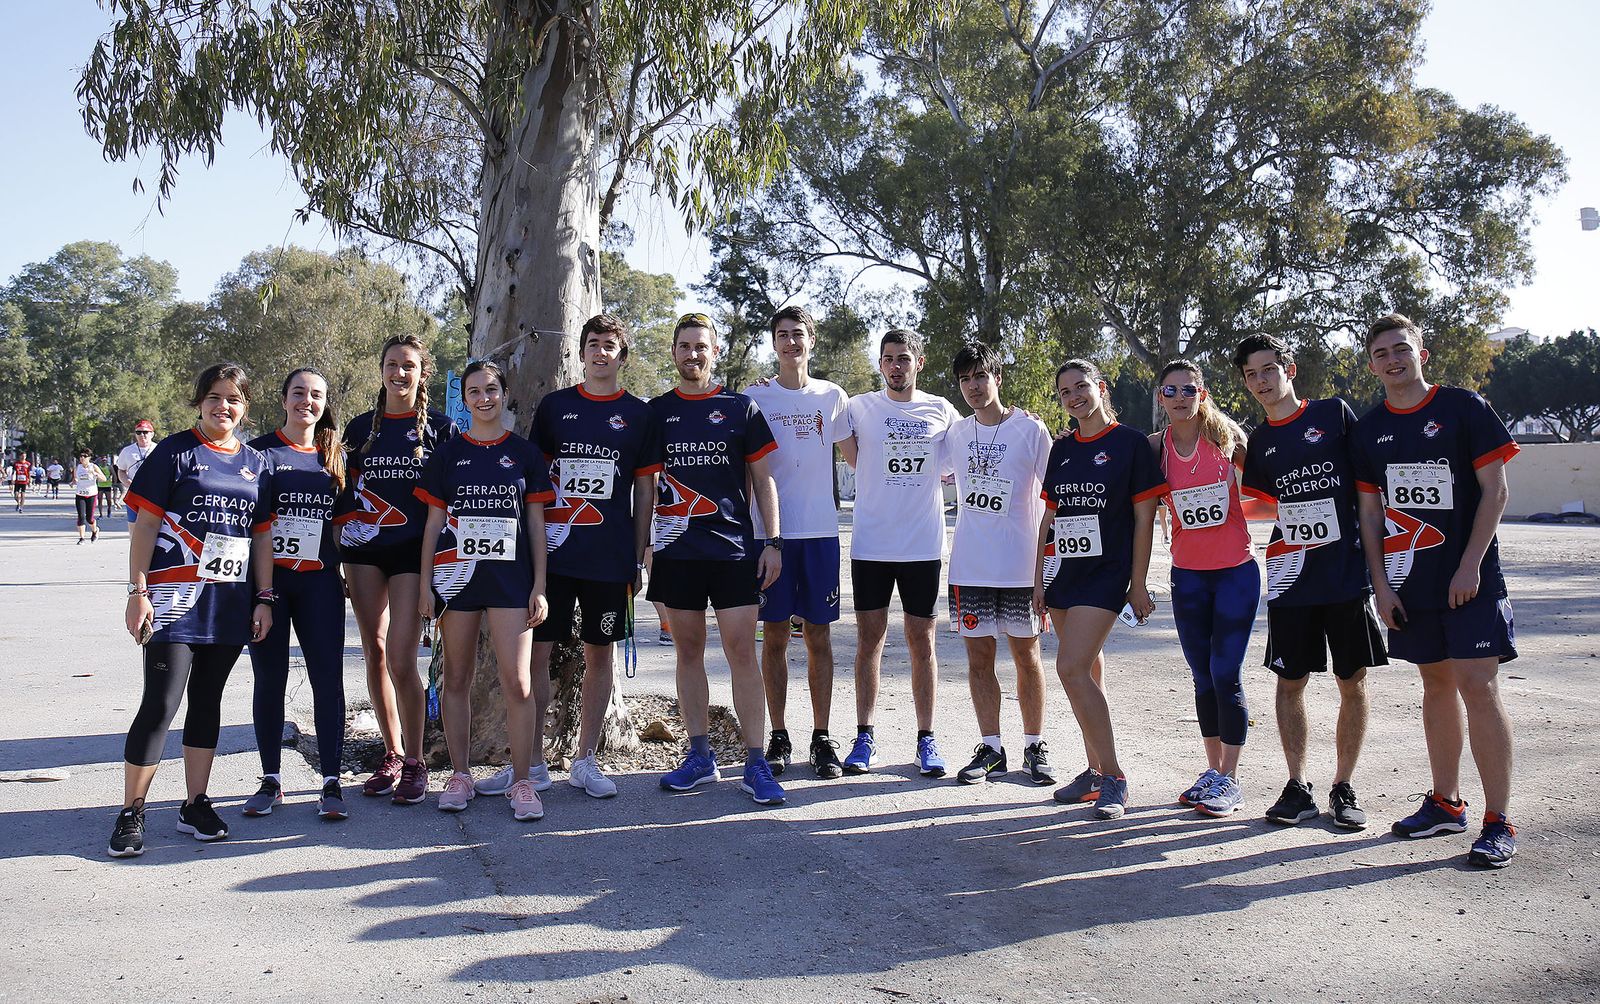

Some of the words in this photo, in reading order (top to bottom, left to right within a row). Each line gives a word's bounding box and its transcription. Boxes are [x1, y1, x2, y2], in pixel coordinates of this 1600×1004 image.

[562, 412, 579, 420] vive
[1377, 434, 1394, 444] vive
[560, 442, 620, 461] CERRADO
[666, 441, 727, 454] CERRADO
[192, 463, 210, 471] vive
[363, 456, 422, 467] CERRADO
[667, 452, 730, 468] CALDERÓN
[888, 458, 925, 473] 637
[364, 467, 422, 481] CALDERÓN
[456, 485, 517, 496] CERRADO
[564, 478, 605, 495] 452
[1054, 482, 1106, 494] CERRADO
[192, 494, 255, 513] CERRADO
[966, 492, 1003, 511] 406
[1395, 486, 1441, 505] 863
[1182, 504, 1223, 526] 666
[1286, 522, 1328, 541] 790
[463, 538, 506, 556] 854
[1058, 537, 1092, 554] 899
[205, 557, 242, 577] 493
[1475, 640, 1491, 649] vive
